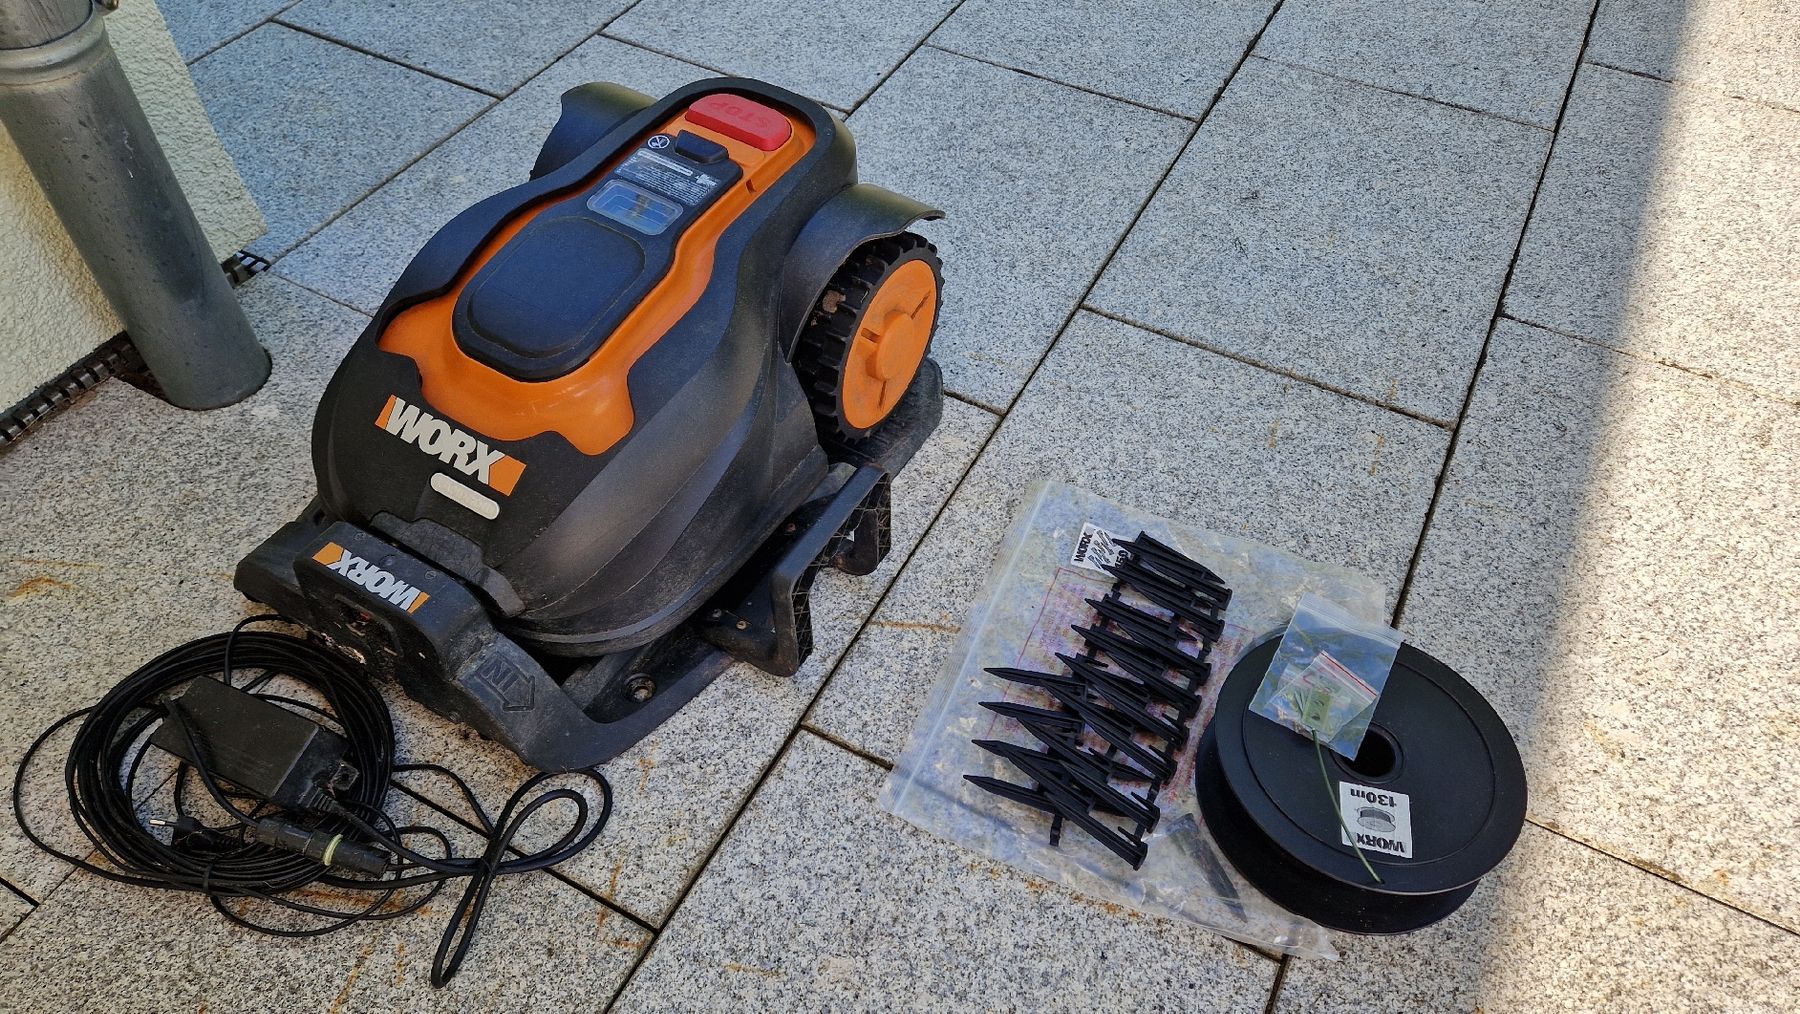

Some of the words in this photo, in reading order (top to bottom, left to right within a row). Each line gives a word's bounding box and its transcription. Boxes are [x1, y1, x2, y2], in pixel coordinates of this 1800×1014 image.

[709, 100, 768, 129] STOP
[384, 397, 505, 485] WORX
[1073, 532, 1093, 562] WORX
[328, 549, 421, 611] WORX
[480, 659, 520, 696] IN
[1350, 788, 1397, 808] 130m
[1356, 833, 1405, 853] WORX
